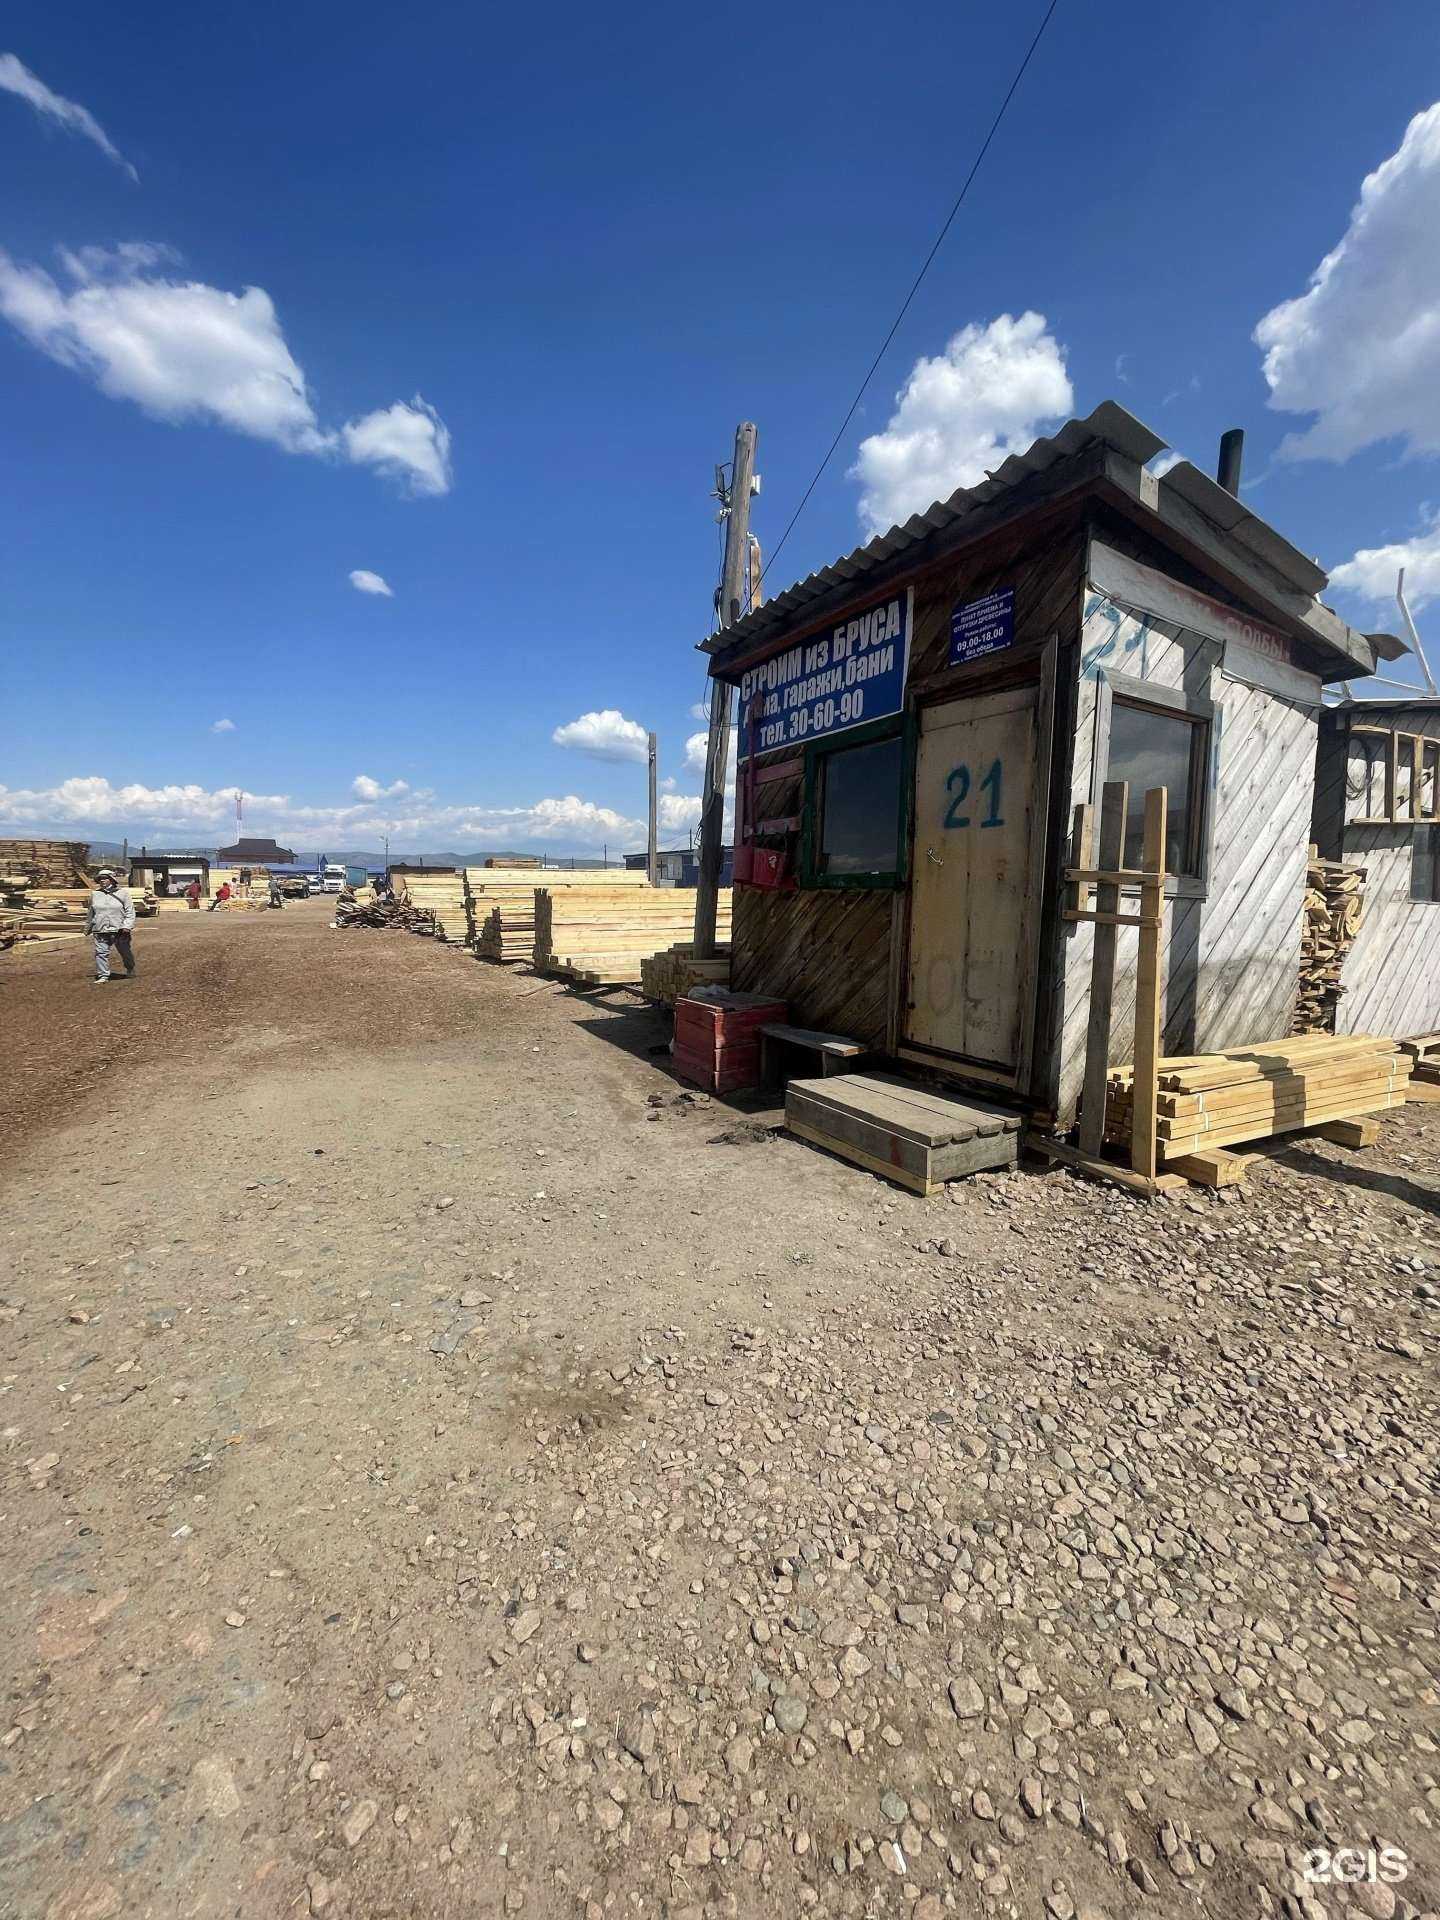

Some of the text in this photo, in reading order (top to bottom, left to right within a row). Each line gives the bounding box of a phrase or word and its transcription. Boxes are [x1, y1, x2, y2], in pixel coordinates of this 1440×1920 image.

[742, 647, 801, 701] СТРОИМ
[806, 640, 829, 674] из
[833, 600, 901, 662] БРУСА
[760, 689, 864, 747] тел. 30-60-90
[943, 758, 1005, 829] 21
